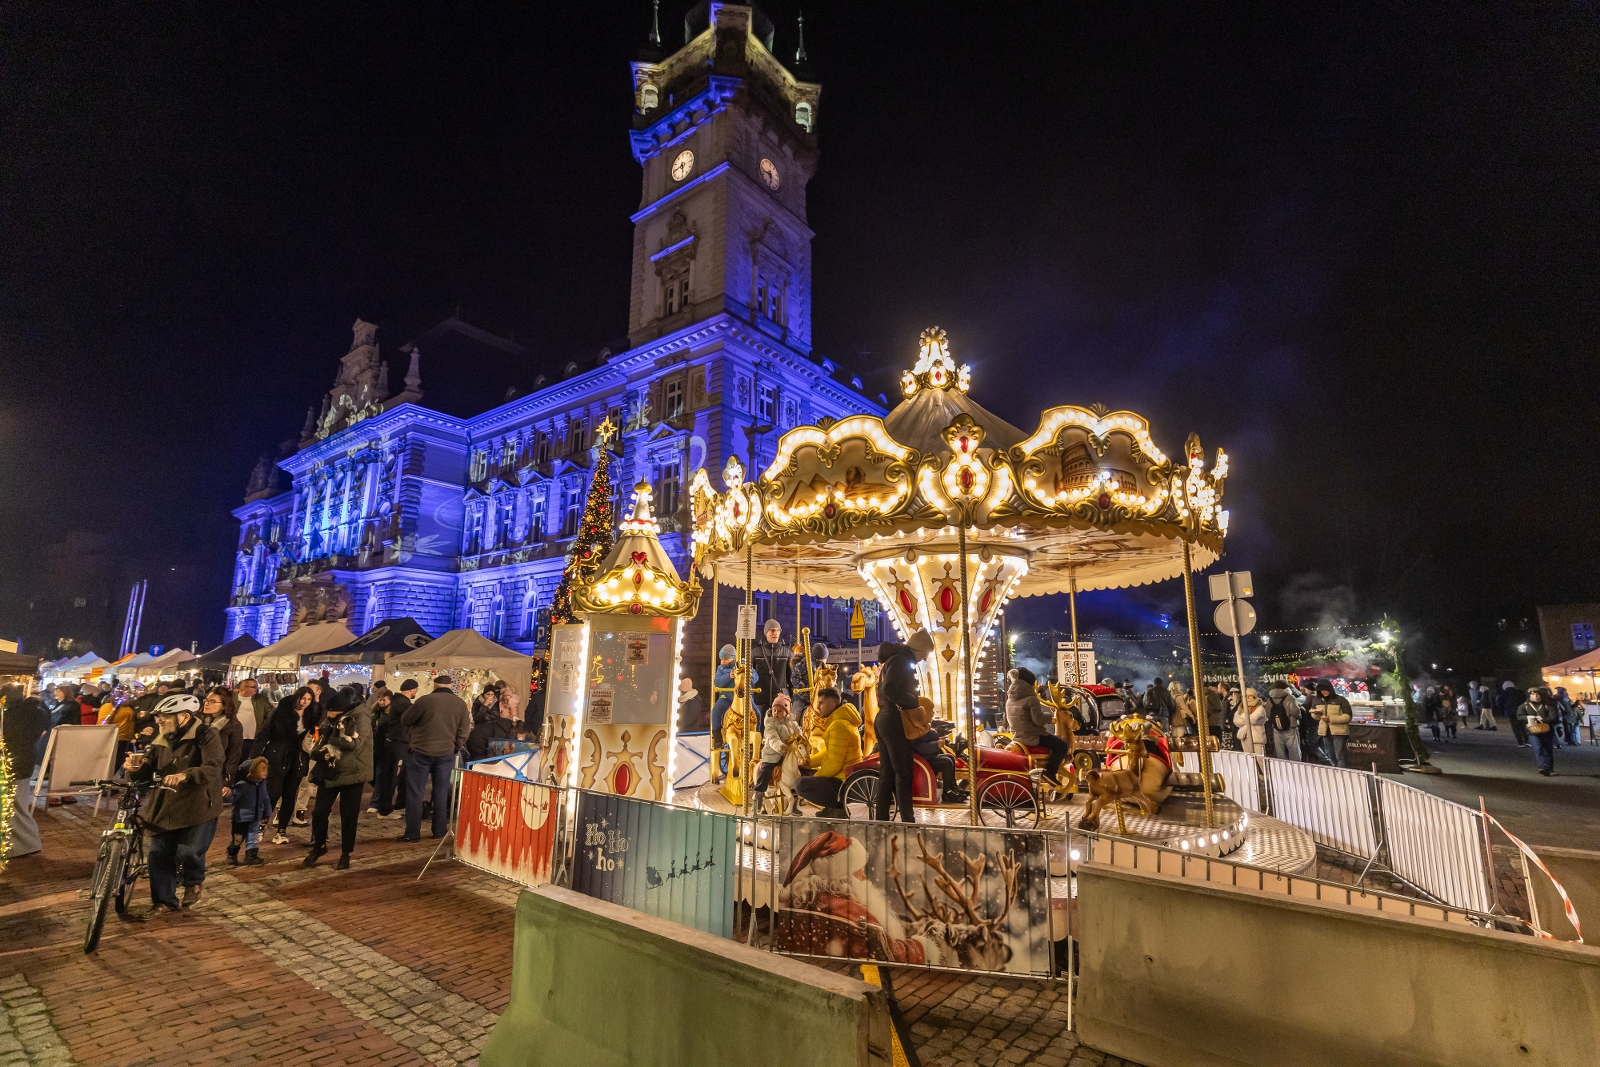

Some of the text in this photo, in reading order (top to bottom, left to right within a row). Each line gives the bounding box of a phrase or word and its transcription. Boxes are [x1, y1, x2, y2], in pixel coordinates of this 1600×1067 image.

[585, 823, 629, 854] Ho Ho
[595, 847, 615, 872] ho
